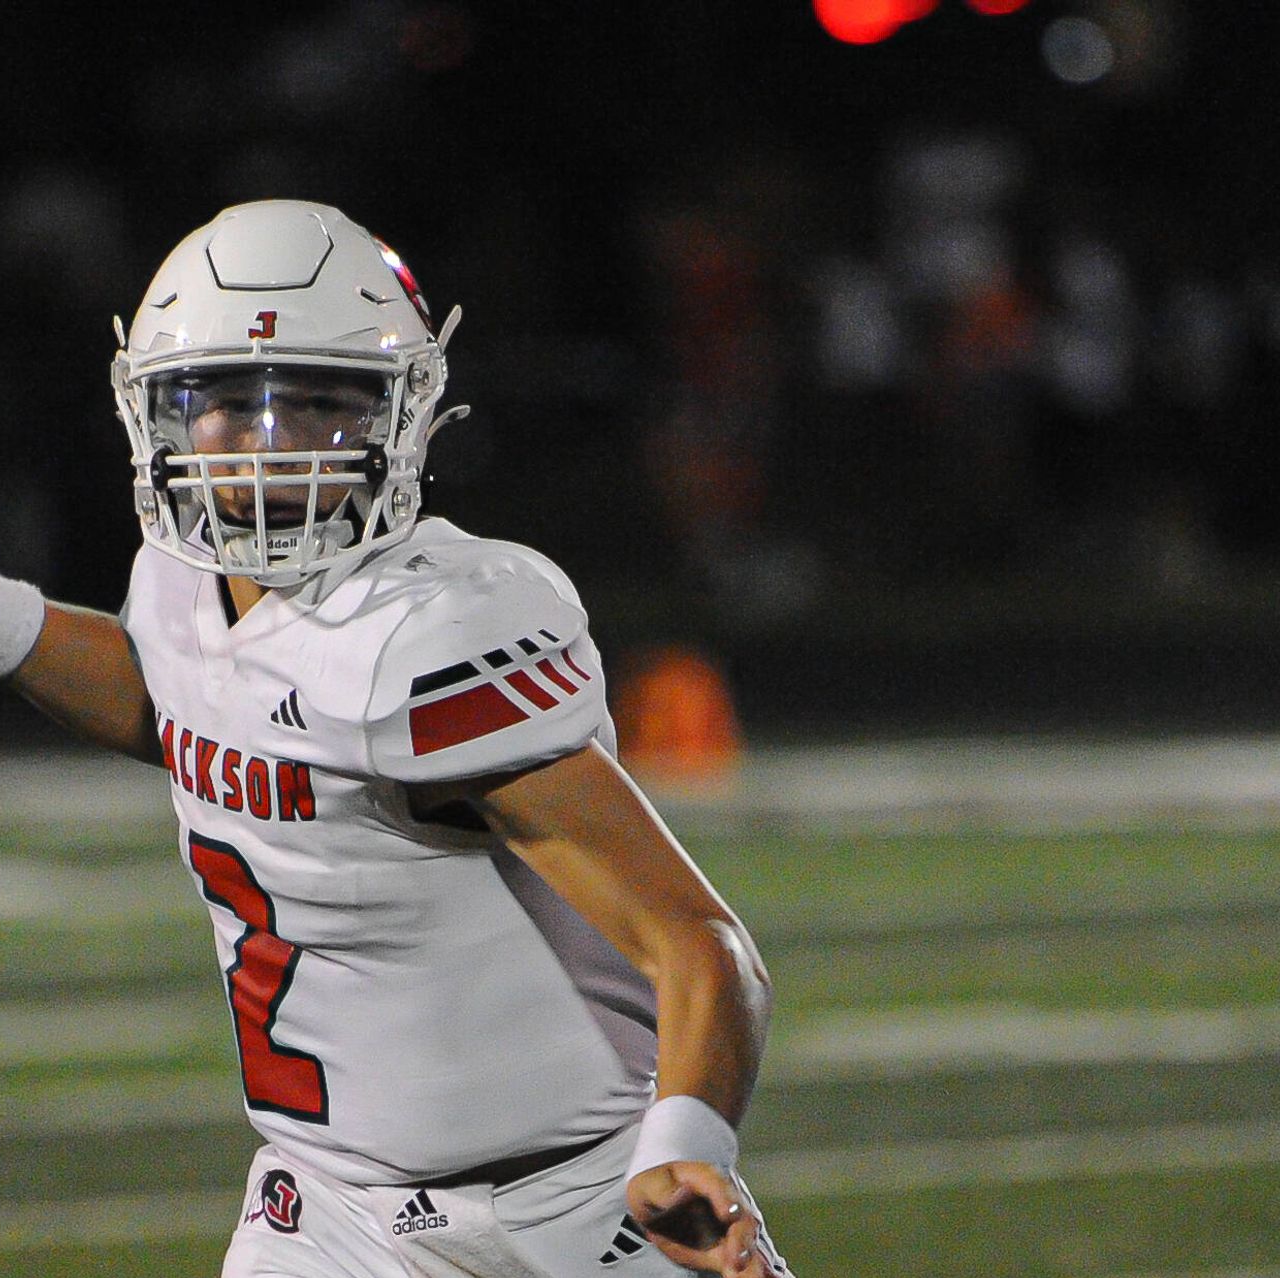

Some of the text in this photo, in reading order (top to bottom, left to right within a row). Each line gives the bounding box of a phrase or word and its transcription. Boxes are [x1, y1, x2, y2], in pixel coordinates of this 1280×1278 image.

[247, 310, 278, 339] J
[254, 537, 298, 549] ddell
[156, 711, 317, 822] ACKSON
[187, 828, 330, 1126] 2
[264, 1179, 298, 1228] J
[392, 1214, 449, 1236] adidas
